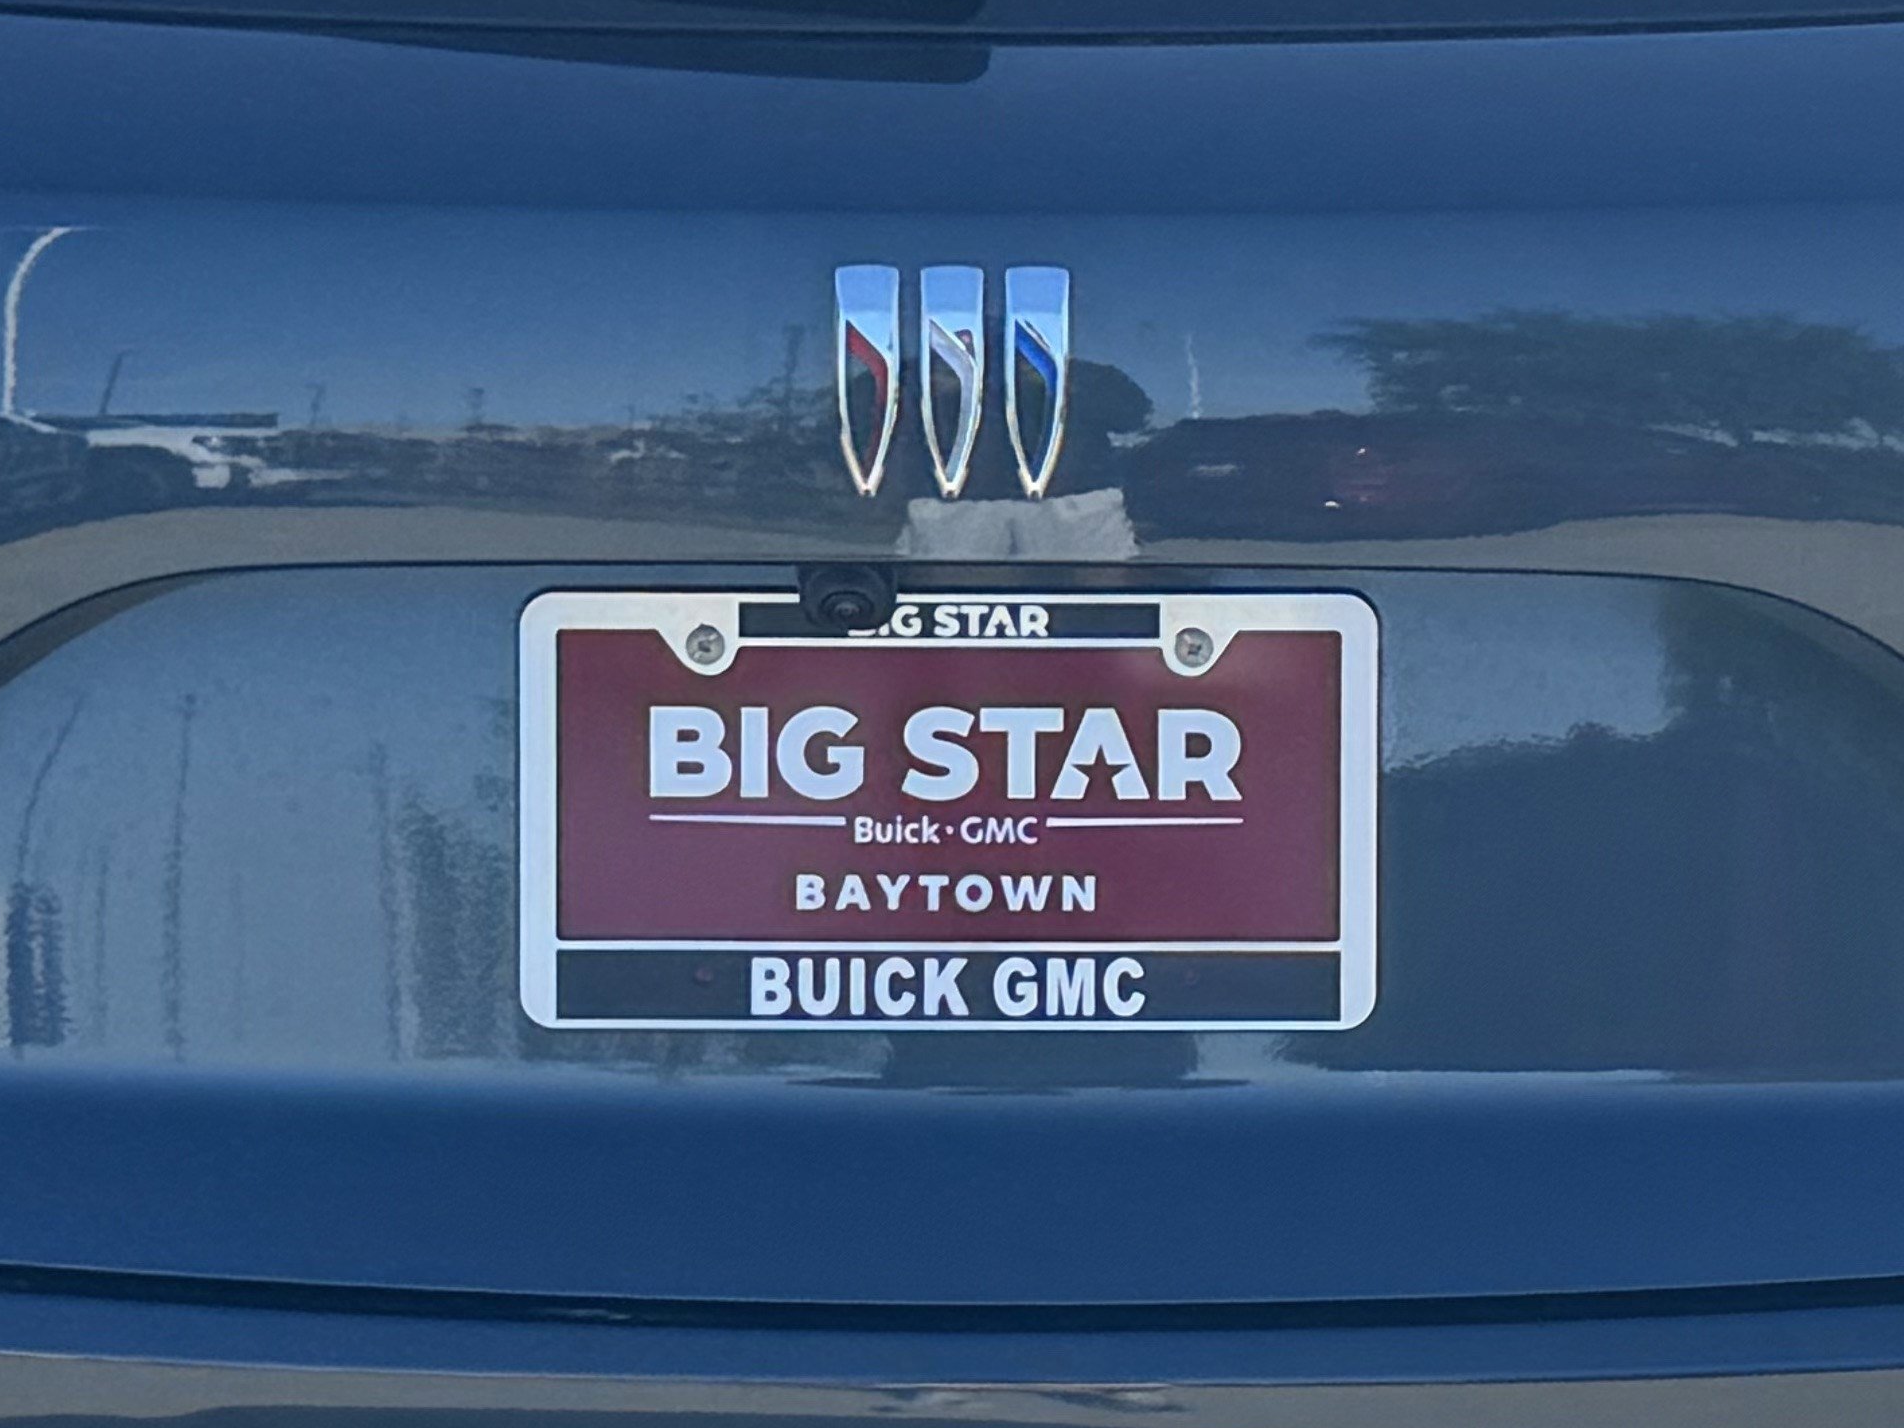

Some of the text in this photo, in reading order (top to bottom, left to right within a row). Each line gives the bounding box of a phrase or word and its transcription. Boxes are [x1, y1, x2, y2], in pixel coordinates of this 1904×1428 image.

[933, 604, 1049, 637] STAR
[649, 705, 1244, 801] BIG STAR
[853, 815, 1039, 845] Buick GMC
[795, 874, 1097, 912] BAYTOWN
[750, 957, 1146, 1018] BUICK GMC
